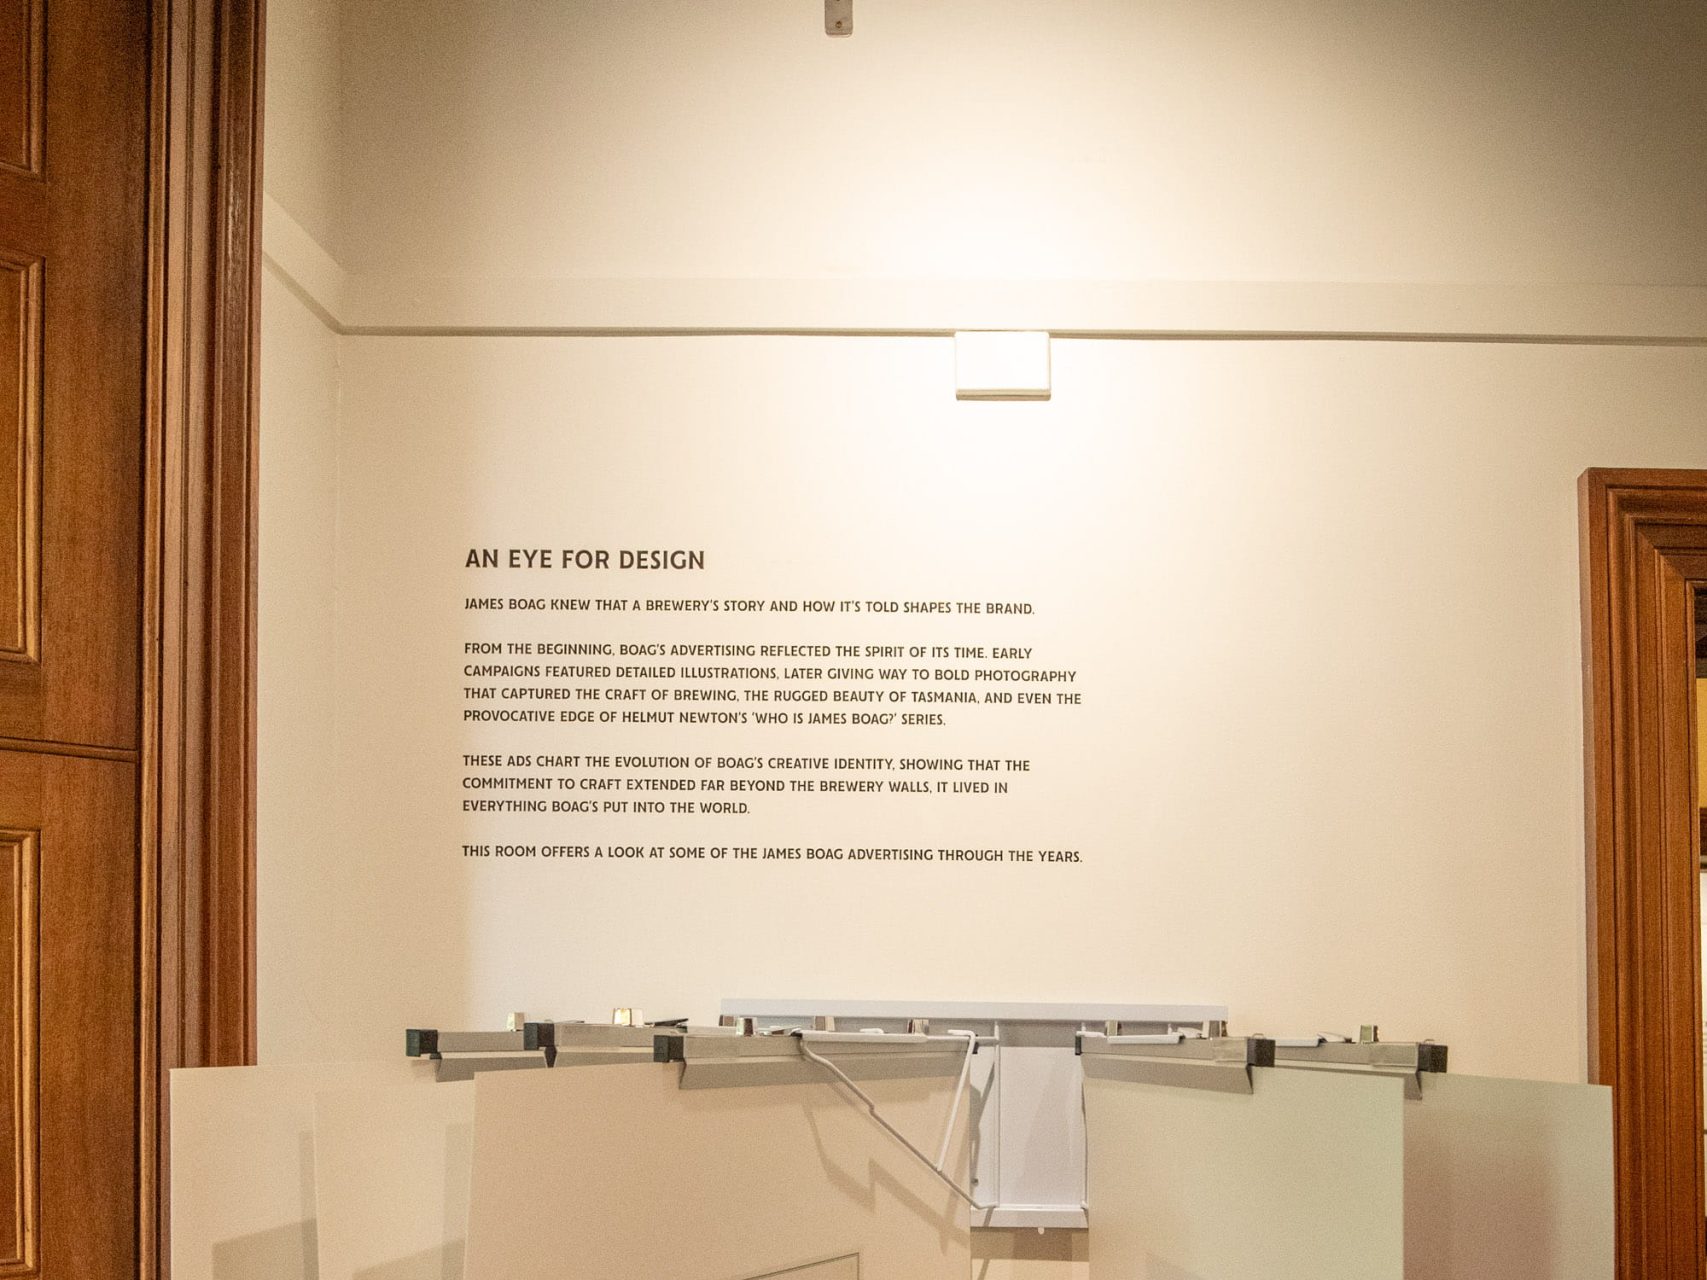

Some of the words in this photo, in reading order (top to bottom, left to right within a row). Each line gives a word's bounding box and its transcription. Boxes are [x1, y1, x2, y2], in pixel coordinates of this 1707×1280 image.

[464, 548, 499, 569] AN
[508, 548, 553, 569] EYE
[561, 549, 610, 570] FOR
[619, 549, 705, 570] DESIGN
[464, 597, 504, 610] JAMES
[508, 598, 546, 611] BOAG
[550, 598, 591, 611] KNEW
[594, 599, 629, 612] THAT
[631, 599, 642, 612] A
[645, 598, 720, 612] BREWERY'S
[723, 599, 766, 612] STORY
[769, 600, 798, 612] AND
[802, 600, 836, 613] HOW
[839, 600, 861, 613] IT'S
[864, 600, 899, 613] TOLD
[903, 601, 952, 614] SHAPES
[955, 601, 981, 614] THE
[985, 602, 1037, 616] BRAND.
[464, 642, 503, 655] FROM
[506, 642, 533, 655] THE
[537, 643, 616, 657] BEGINNING,
[619, 643, 666, 656] BOAG'S
[670, 644, 756, 657] ADVERTISING
[760, 644, 832, 657] REFLECTED
[834, 645, 861, 658] THE
[864, 645, 905, 658] SPIRIT
[908, 646, 927, 658] OF
[931, 646, 950, 659] ITS
[953, 646, 988, 659] TIME.
[992, 647, 1033, 660] EARLY
[463, 664, 541, 678] CAMPAIGNS
[545, 665, 611, 678] FEATURED
[615, 666, 676, 679] DETAILED
[680, 666, 780, 680] ILLUSTRATIONS,
[784, 667, 823, 680] LATER
[827, 667, 874, 680] GIVING
[878, 668, 908, 681] WAY
[911, 668, 930, 681] TO
[934, 668, 970, 681] BOLD
[974, 669, 1077, 683] PHOTOGRAPHY
[463, 687, 497, 699] THAT
[501, 687, 571, 700] CAPTURED
[575, 688, 601, 701] THE
[604, 688, 647, 701] CRAFT
[650, 688, 670, 701] OF
[673, 689, 740, 702] BREWING,
[743, 689, 769, 702] THE
[773, 689, 829, 702] RUGGED
[833, 690, 885, 703] BEAUTY
[888, 690, 907, 703] OF
[910, 691, 980, 705] TASMANIA,
[983, 691, 1013, 704] AND
[1017, 692, 1052, 705] EVEN
[1055, 692, 1082, 705] THE
[463, 709, 556, 722] PROVOCATIVE
[560, 710, 595, 723] EDGE
[599, 710, 618, 723] OF
[622, 711, 675, 724] HELMUT
[679, 711, 748, 724] NEWTON'S
[793, 712, 804, 725] IS
[807, 712, 847, 725] JAMES
[901, 713, 947, 727] SERIES.
[462, 754, 503, 767] THESE
[506, 754, 532, 767] ADS
[535, 755, 581, 768] CHART
[584, 755, 611, 768] THE
[614, 756, 690, 769] EVOLUTION
[694, 756, 713, 769] OF
[716, 756, 764, 769] BOAG'S
[767, 757, 830, 770] CREATIVE
[834, 757, 896, 771] IDENTITY,
[899, 758, 964, 771] SHOWING
[967, 759, 1001, 772] THAT
[1004, 759, 1031, 772] THE
[462, 776, 553, 790] COMMITMENT
[556, 777, 576, 790] TO
[579, 778, 622, 791] CRAFT
[626, 778, 696, 791] EXTENDED
[700, 779, 725, 792] FAR
[729, 779, 786, 792] BEYOND
[789, 779, 815, 792] THE
[819, 780, 884, 793] BREWERY
[888, 780, 933, 794] WALLS,
[936, 781, 949, 793] IT
[952, 781, 990, 794] LIVED
[994, 781, 1008, 794] IN
[462, 799, 548, 813] EVERYTHING
[551, 800, 599, 813] BOAG'S
[603, 801, 629, 814] PUT
[633, 801, 666, 814] INTO
[669, 801, 695, 814] THE
[699, 801, 751, 815] WORLD.
[461, 844, 491, 857] THIS
[495, 844, 537, 858] ROOM
[540, 845, 590, 858] OFFERS
[593, 845, 604, 858] A
[607, 846, 645, 859] LOOK
[648, 846, 665, 859] AT
[668, 846, 706, 859] SOME
[709, 846, 729, 860] OF
[732, 847, 758, 860] THE
[761, 847, 802, 860] JAMES
[806, 847, 844, 860] BOAG
[847, 848, 934, 861] ADVERTISING
[937, 849, 1004, 862] THROUGH
[1007, 849, 1034, 862] THE
[1037, 850, 1083, 863] YEARS.
